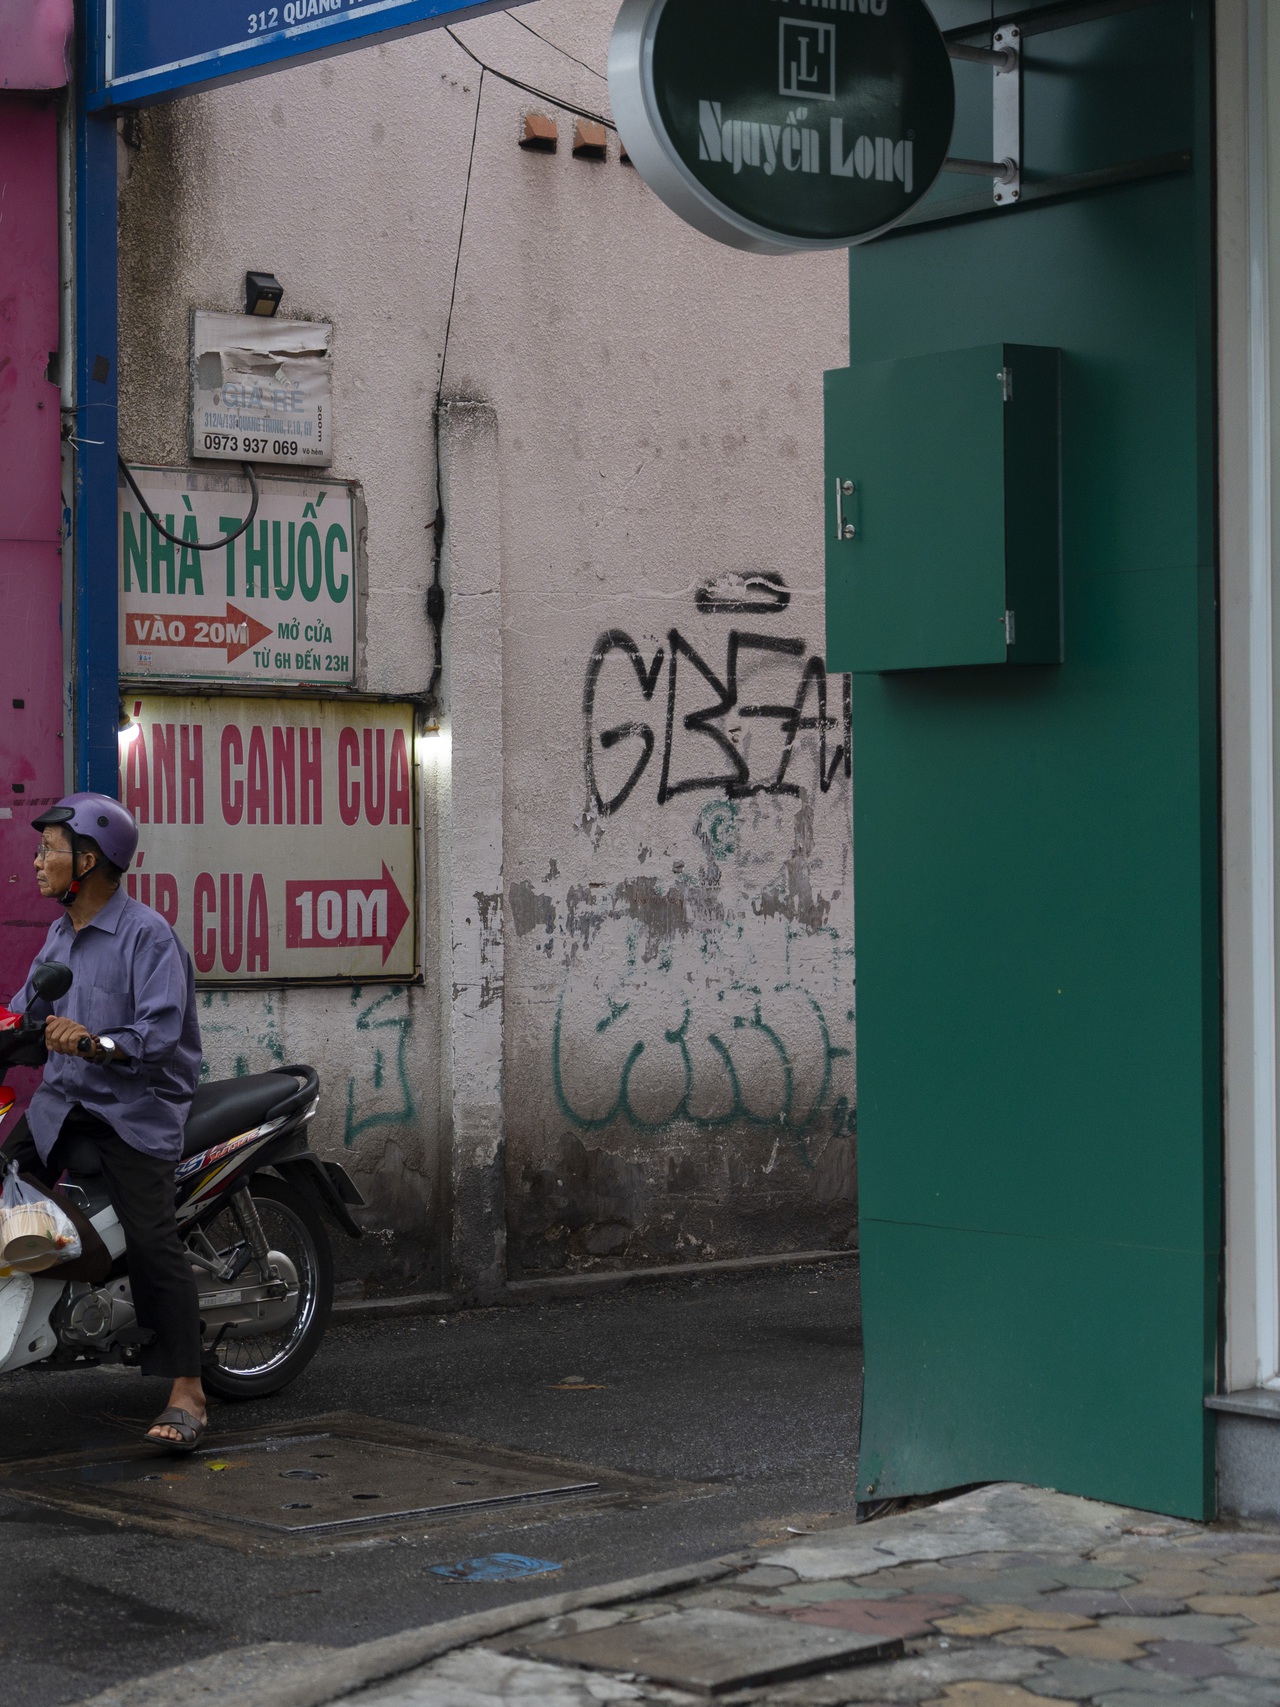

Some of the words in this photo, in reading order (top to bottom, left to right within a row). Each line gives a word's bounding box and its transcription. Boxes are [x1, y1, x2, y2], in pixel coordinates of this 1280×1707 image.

[247, 7, 278, 34] 312
[283, 0, 341, 25] QUANG
[830, 117, 913, 193] Long
[238, 415, 261, 433] QUANG
[204, 434, 238, 452] 0973
[243, 437, 268, 454] 937
[273, 440, 298, 456] 069
[122, 495, 204, 596] NHÀ
[219, 491, 349, 604] THUỐC
[133, 614, 186, 643] VÀO
[194, 622, 247, 646] 20M
[277, 620, 300, 641] MỞ
[304, 618, 332, 643] CỬA
[253, 650, 271, 669] TỪ
[274, 653, 291, 670] 6H
[295, 650, 320, 672] ĐẾN
[325, 655, 349, 673] 23H
[119, 701, 204, 824] ÁNH
[220, 724, 323, 826] CANH
[338, 726, 411, 826] CUA
[193, 872, 269, 974] CUA
[295, 889, 388, 940] 10M
